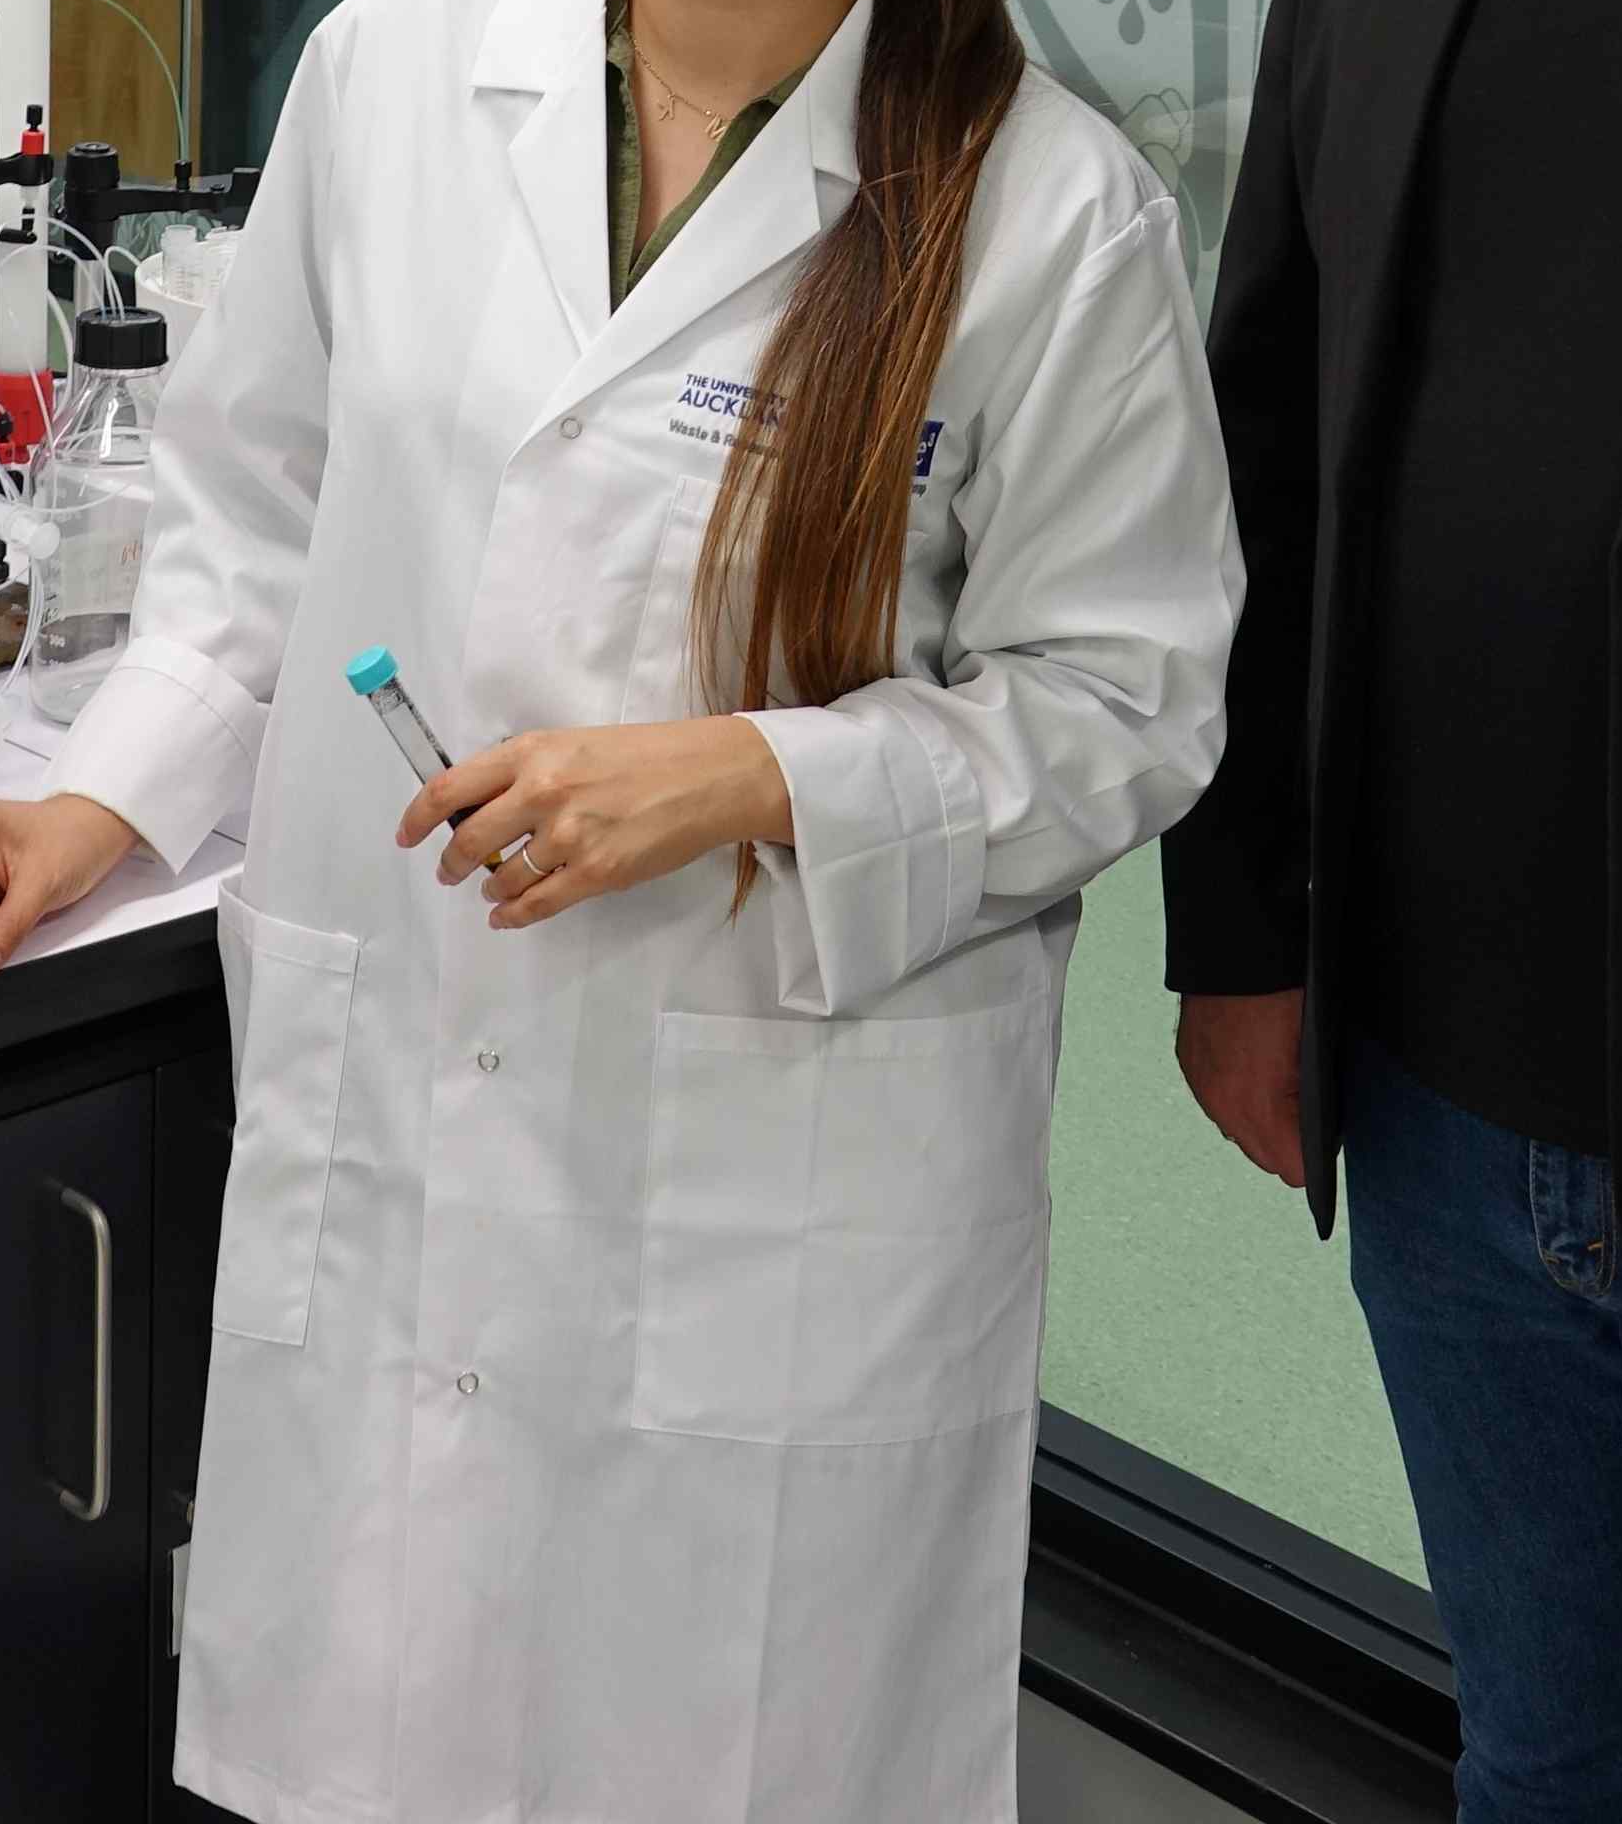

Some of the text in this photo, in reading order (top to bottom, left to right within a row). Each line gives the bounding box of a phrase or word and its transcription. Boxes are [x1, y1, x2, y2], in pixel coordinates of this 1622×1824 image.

[685, 374, 709, 388] THE
[678, 387, 749, 420] AUCKL
[668, 417, 709, 442] Waste
[710, 430, 721, 444] &
